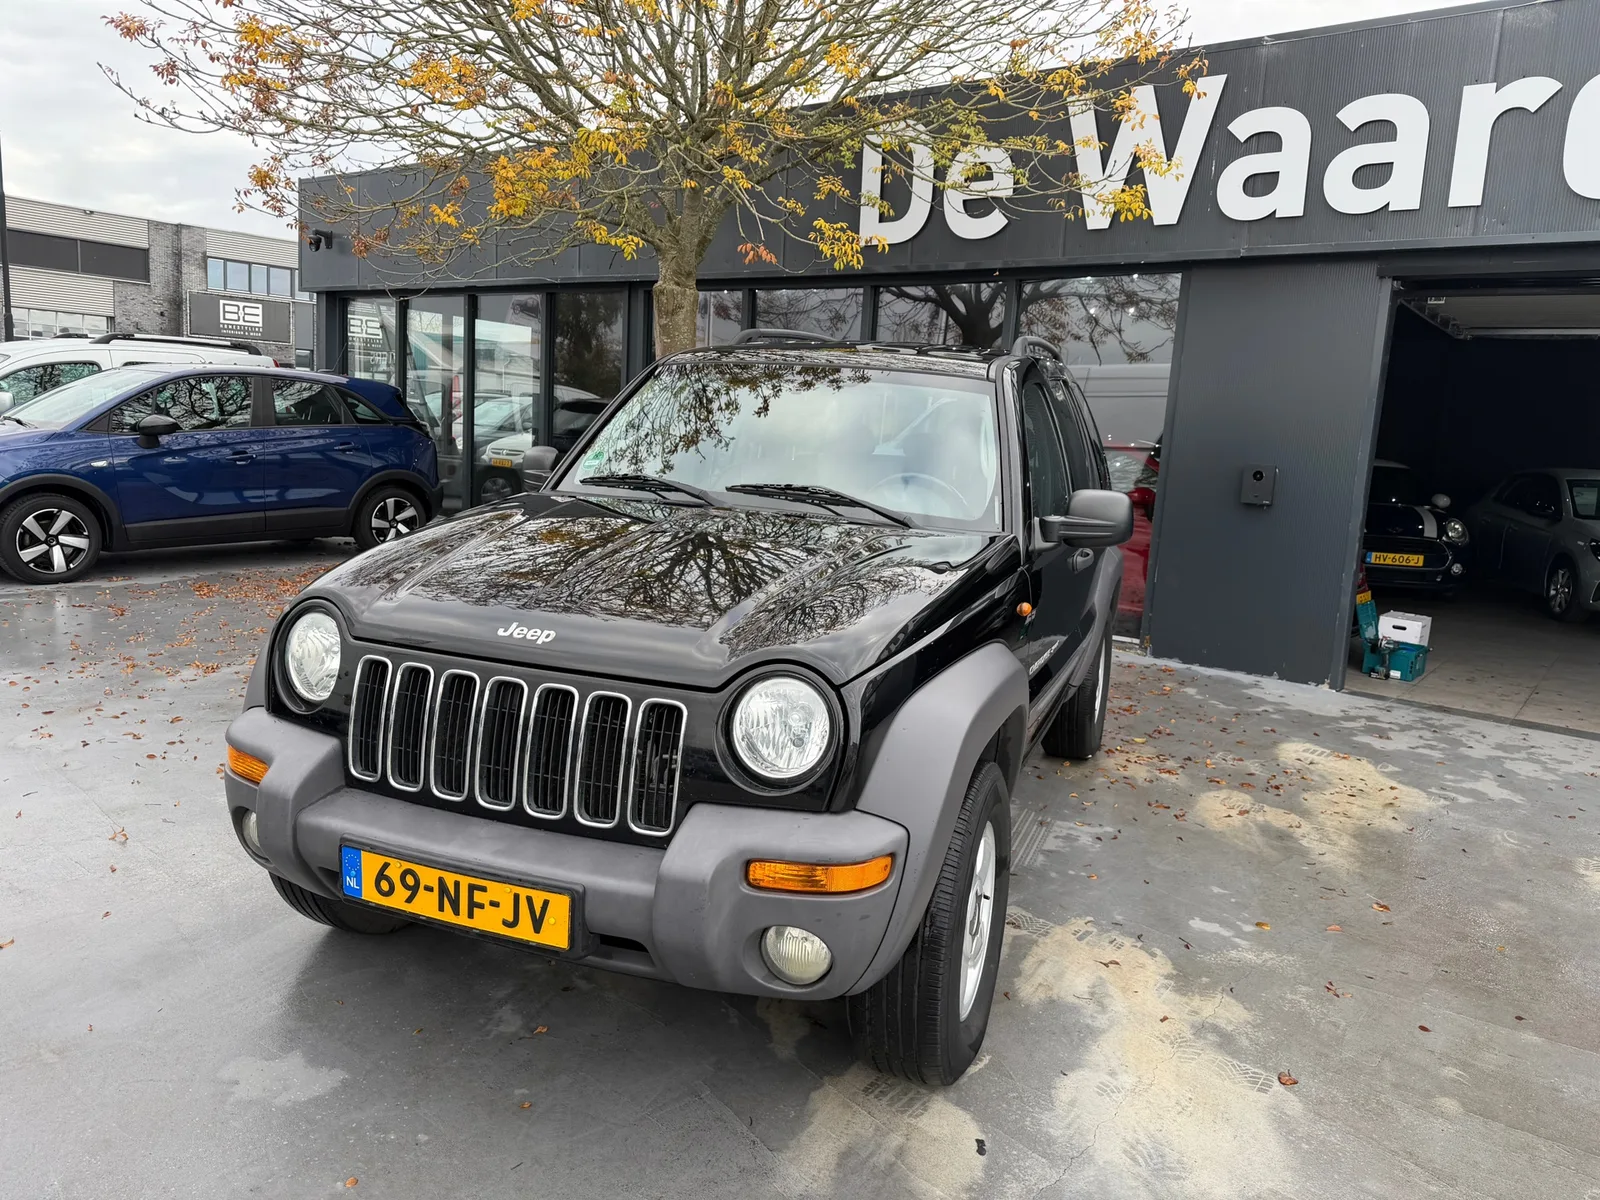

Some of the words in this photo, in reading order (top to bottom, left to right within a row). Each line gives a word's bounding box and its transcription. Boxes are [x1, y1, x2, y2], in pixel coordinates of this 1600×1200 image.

[859, 120, 1014, 246] De
[1374, 553, 1420, 565] HV-606-J
[497, 621, 557, 645] Jeep
[345, 875, 360, 889] NL
[374, 861, 551, 934] 69-NF-JV
